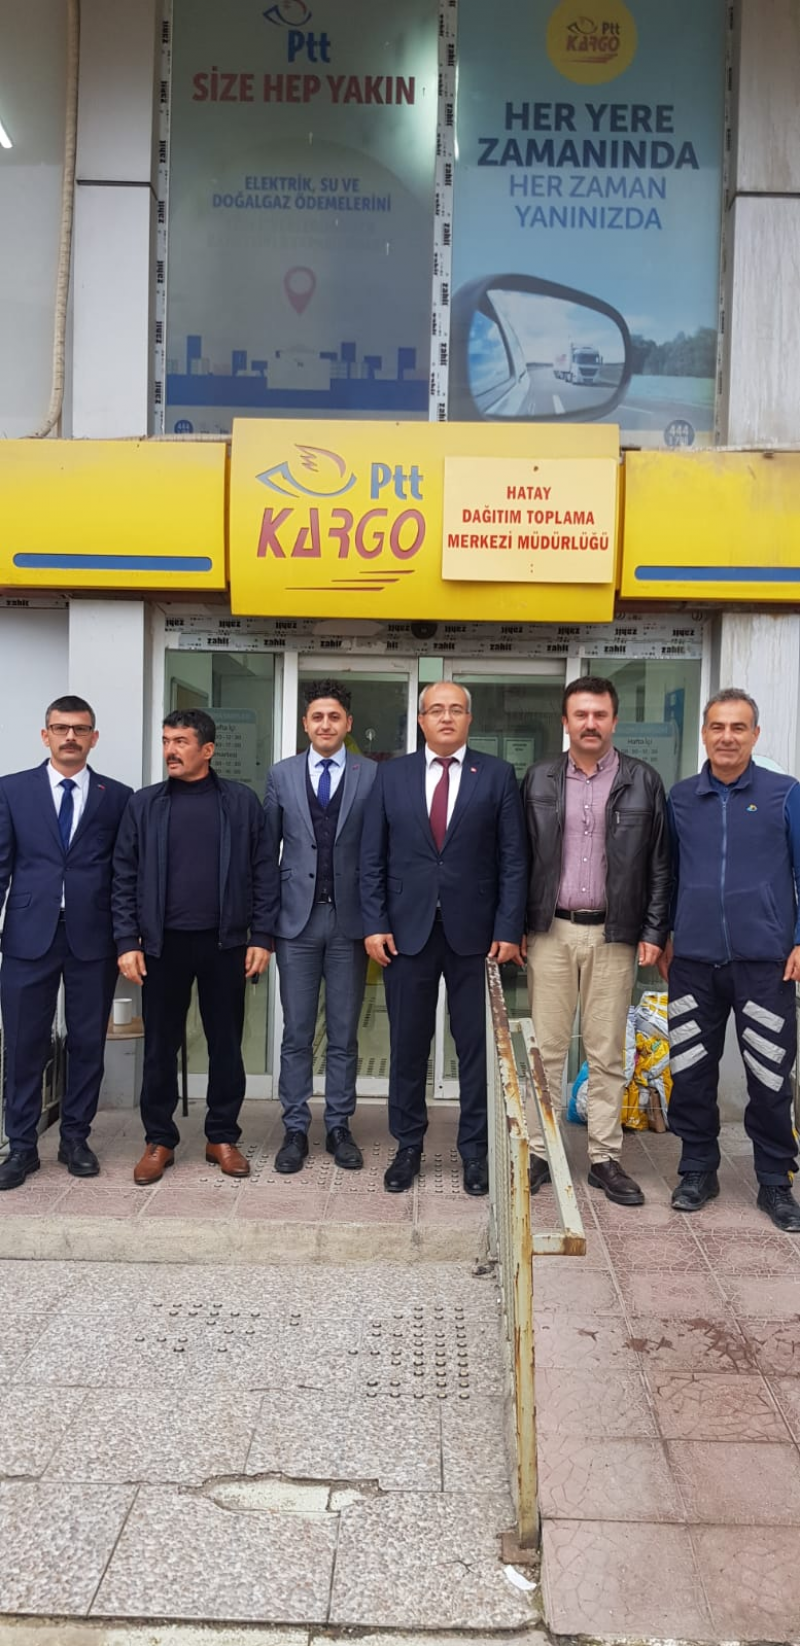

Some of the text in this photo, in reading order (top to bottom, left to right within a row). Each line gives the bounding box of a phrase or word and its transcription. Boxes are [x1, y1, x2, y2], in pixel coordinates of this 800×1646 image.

[287, 29, 331, 63] Ptt
[566, 35, 620, 52] KARGO
[192, 65, 416, 105] SİZE HEP YAKIN
[504, 102, 675, 134] HER YERE
[477, 138, 700, 170] ZAMANINDA
[245, 174, 360, 194] ELEKTRİK, SU VE
[509, 174, 667, 200] HER ZAMAN
[212, 191, 392, 212] DOĞALGAZ ÖDEMELERİNİ
[514, 205, 663, 230] YANINIZDA
[369, 462, 424, 501] Ptt
[506, 485, 551, 501] HATAY
[461, 505, 595, 526] DAĞITIM TOPLAMA
[256, 507, 427, 560] KARGO
[447, 530, 610, 552] MERKEZİ MÜDÜRLÜĞÜ
